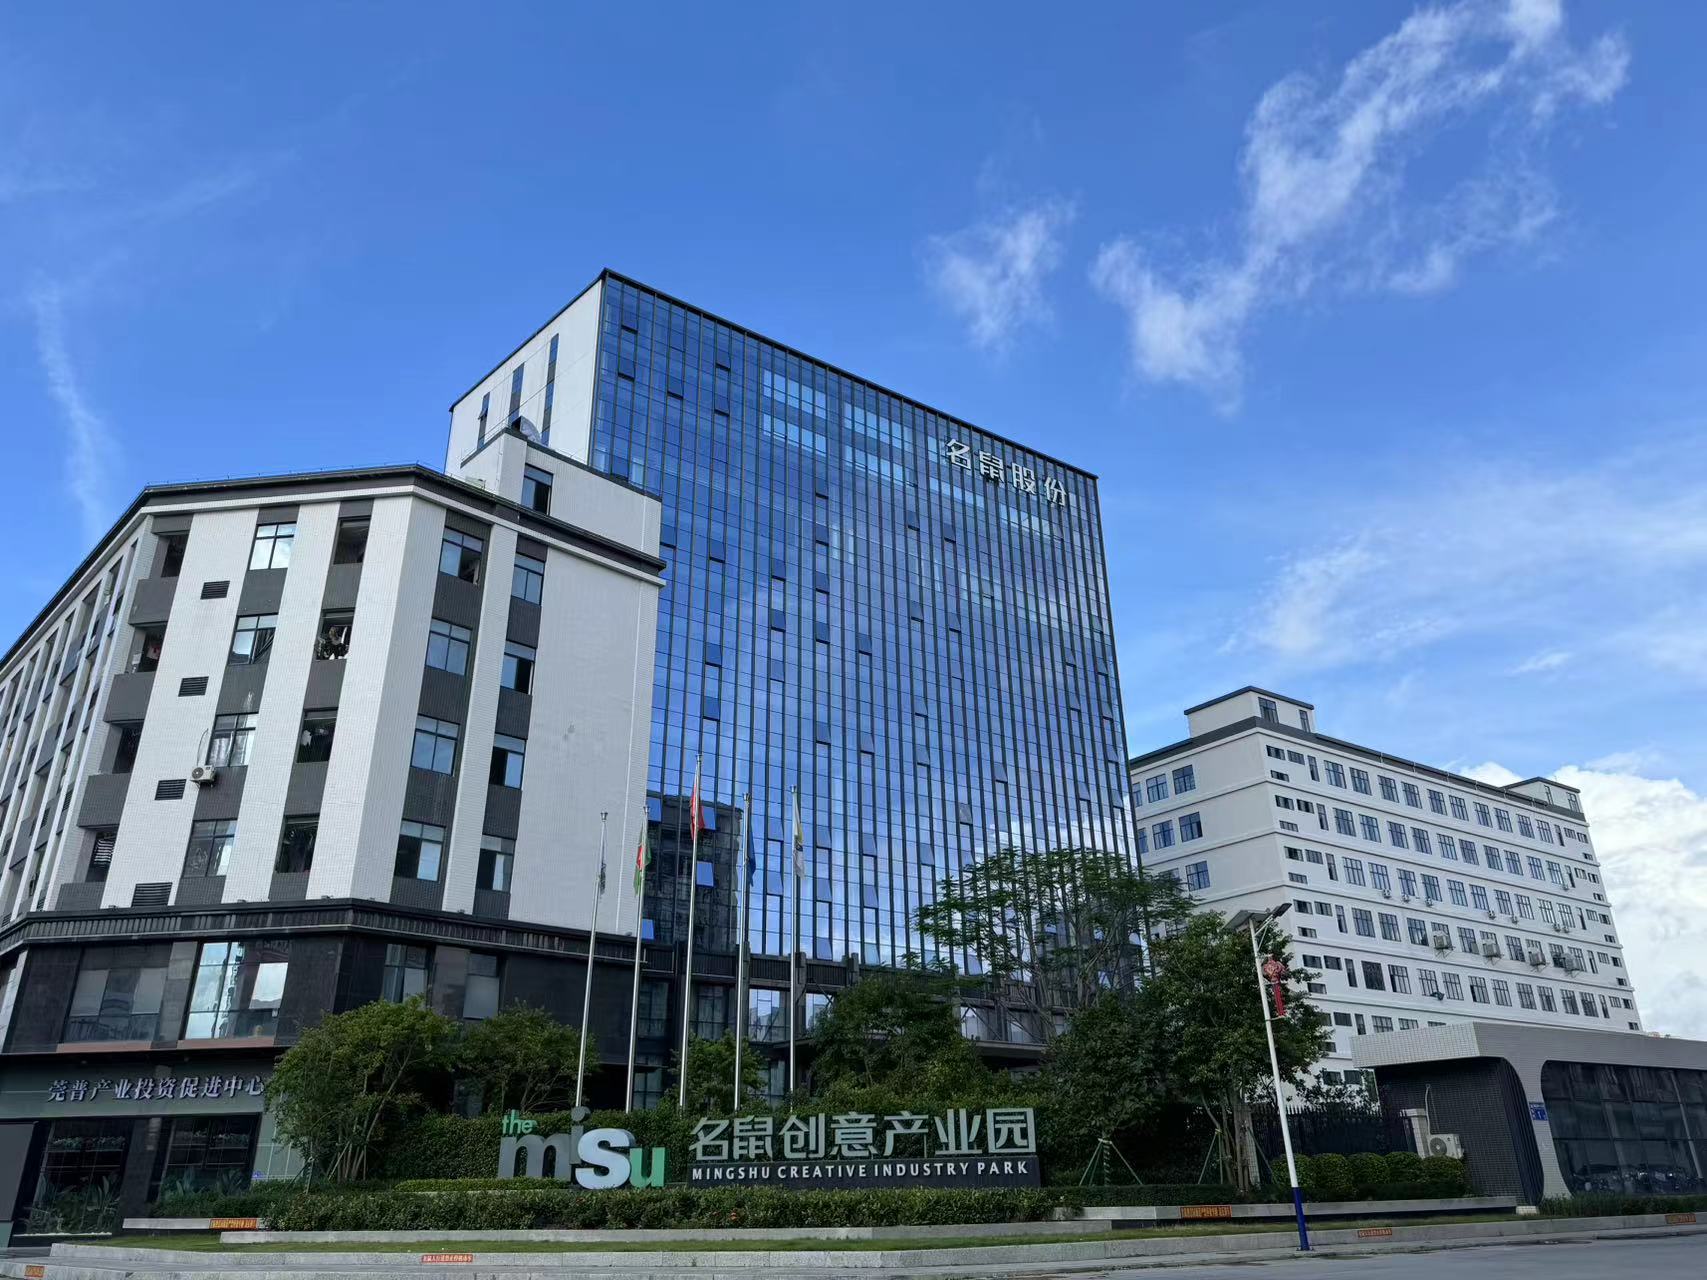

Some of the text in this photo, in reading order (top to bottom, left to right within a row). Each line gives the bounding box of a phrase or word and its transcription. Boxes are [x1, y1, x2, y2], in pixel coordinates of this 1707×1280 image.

[945, 438, 1067, 506] 名鼠股份
[48, 1075, 265, 1101] 莞普产业投资促进中心
[501, 1109, 535, 1134] the
[688, 1107, 1036, 1161] 名鼠创意产业园
[692, 1160, 1029, 1180] MINGSHU CREATIVE INDUSTRY PARK
